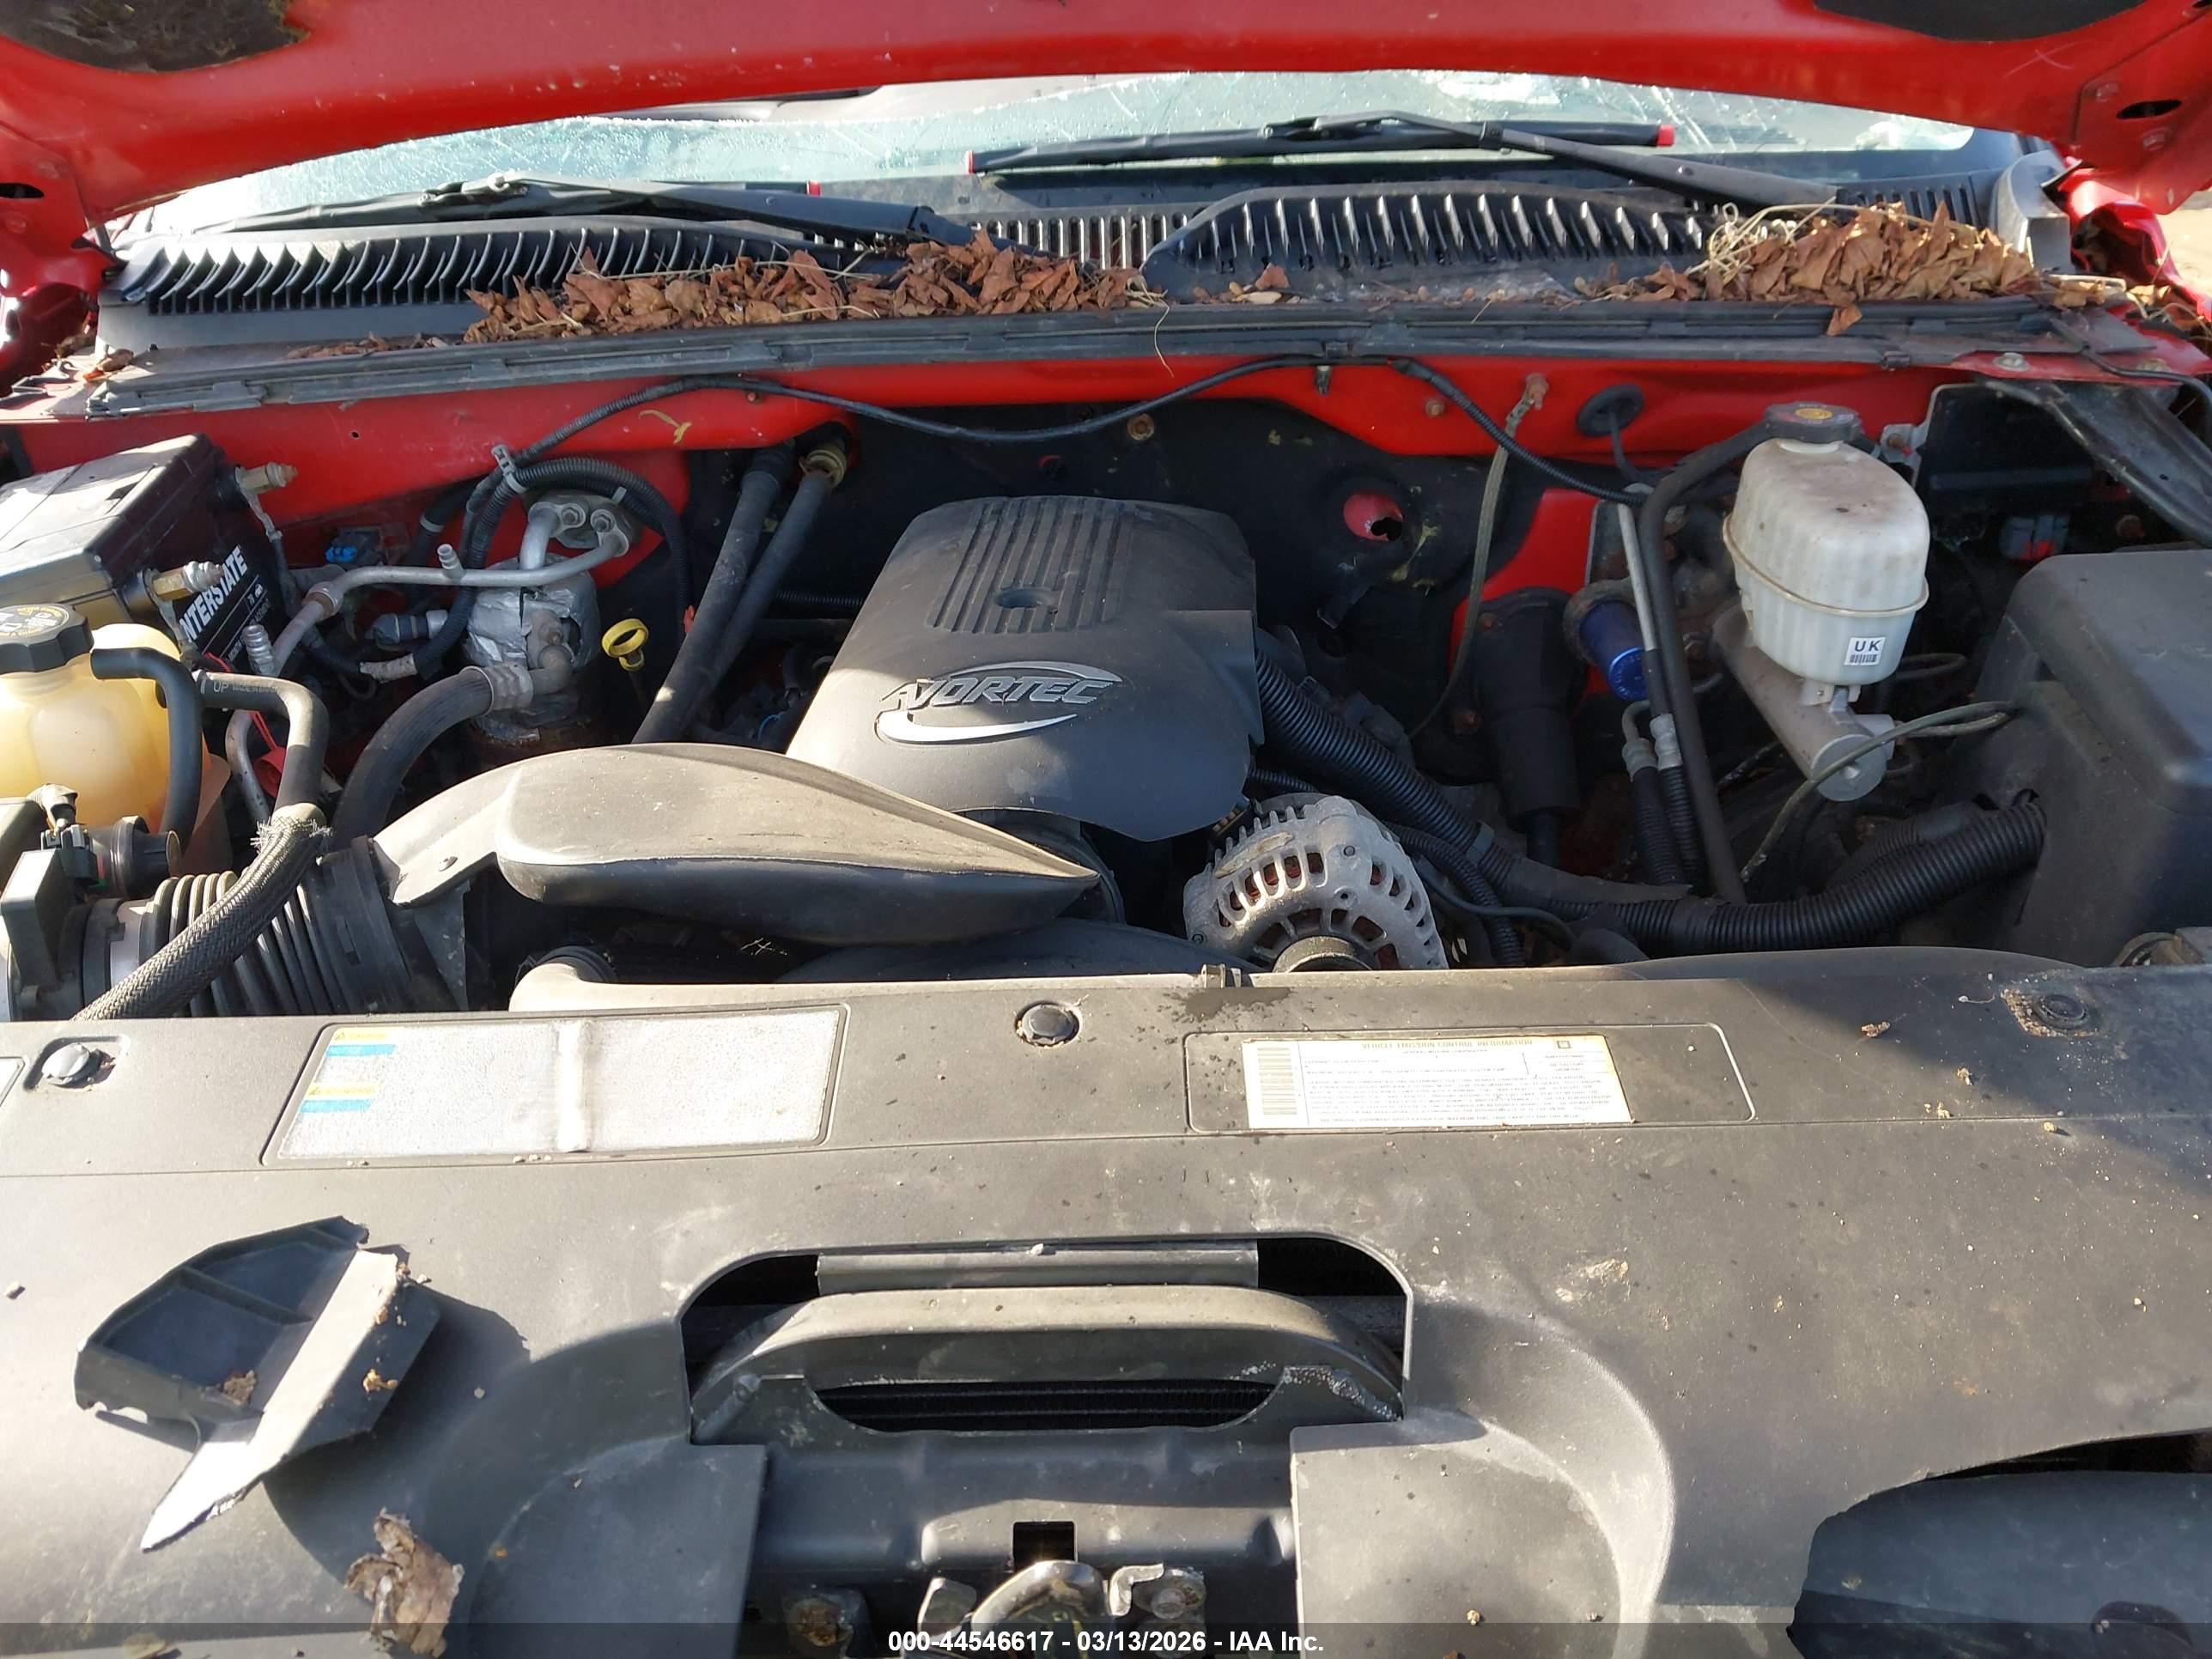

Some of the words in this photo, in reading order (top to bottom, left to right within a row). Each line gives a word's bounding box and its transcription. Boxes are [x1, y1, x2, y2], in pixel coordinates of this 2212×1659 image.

[179, 544, 248, 642] NTERSTATE
[1855, 641, 1881, 652] UK
[906, 676, 1114, 710] VORTEC
